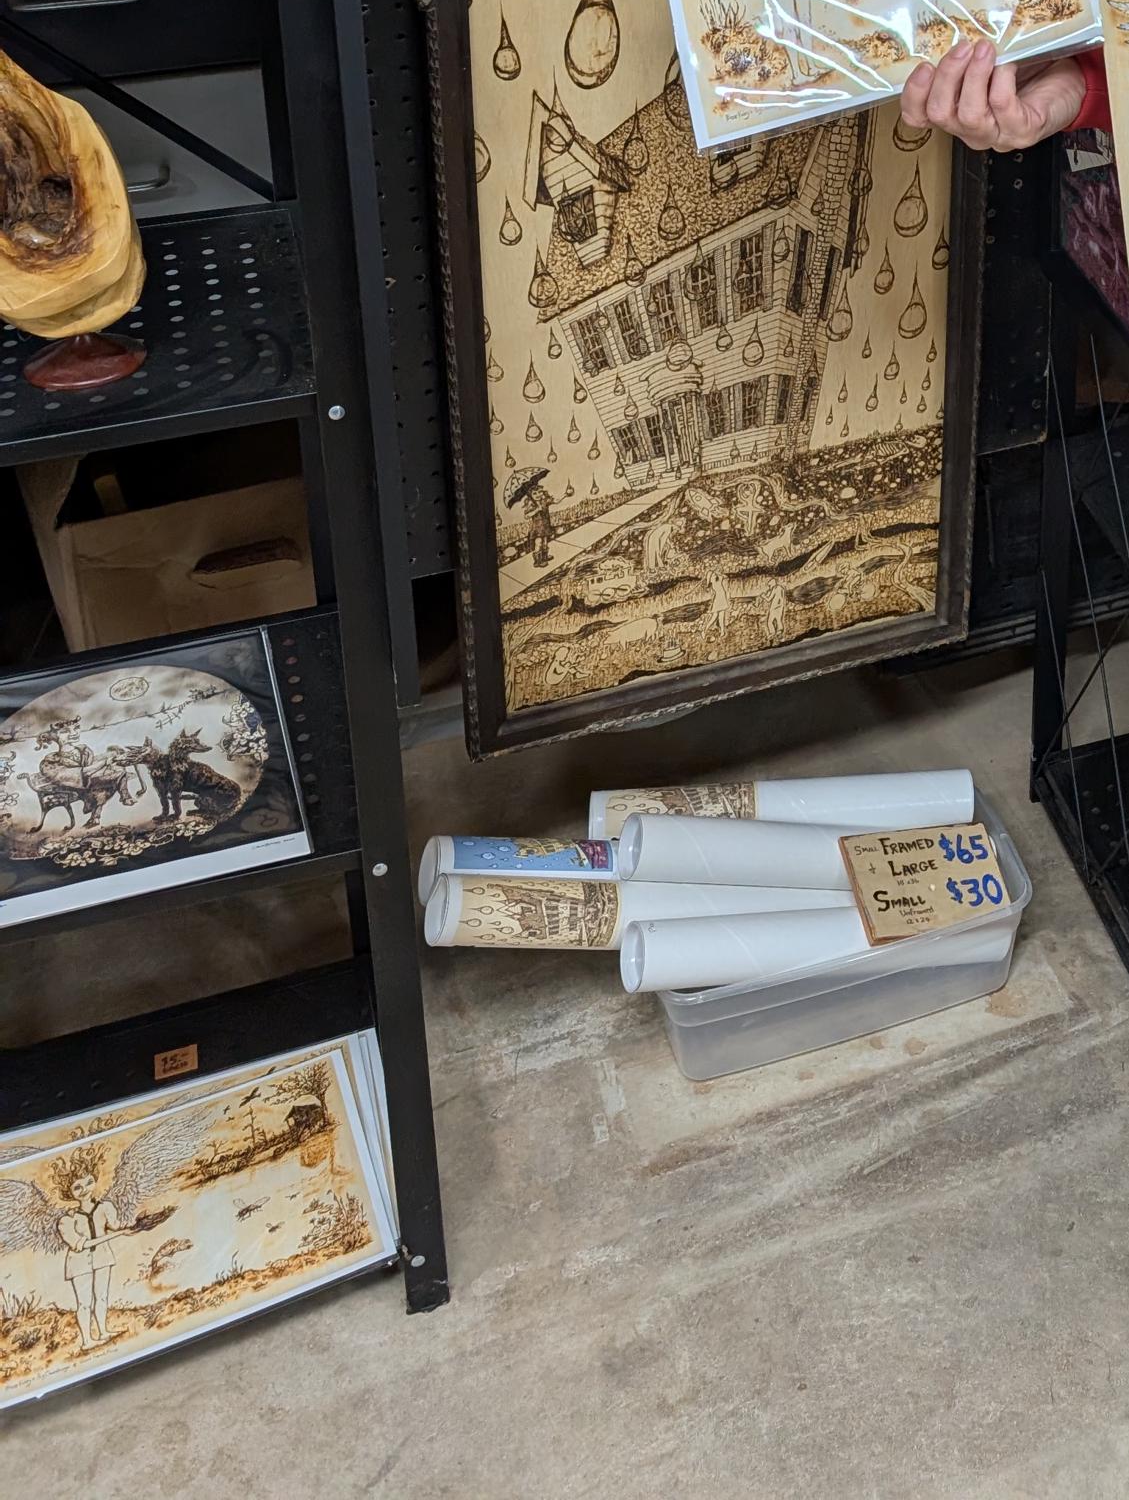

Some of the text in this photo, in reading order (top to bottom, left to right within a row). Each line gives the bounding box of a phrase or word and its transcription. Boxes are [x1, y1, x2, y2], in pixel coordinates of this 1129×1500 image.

[878, 837, 934, 856] FRAMED
[938, 833, 988, 864] $65
[888, 859, 938, 877] LARGE
[873, 874, 1003, 912] SMALL $30
